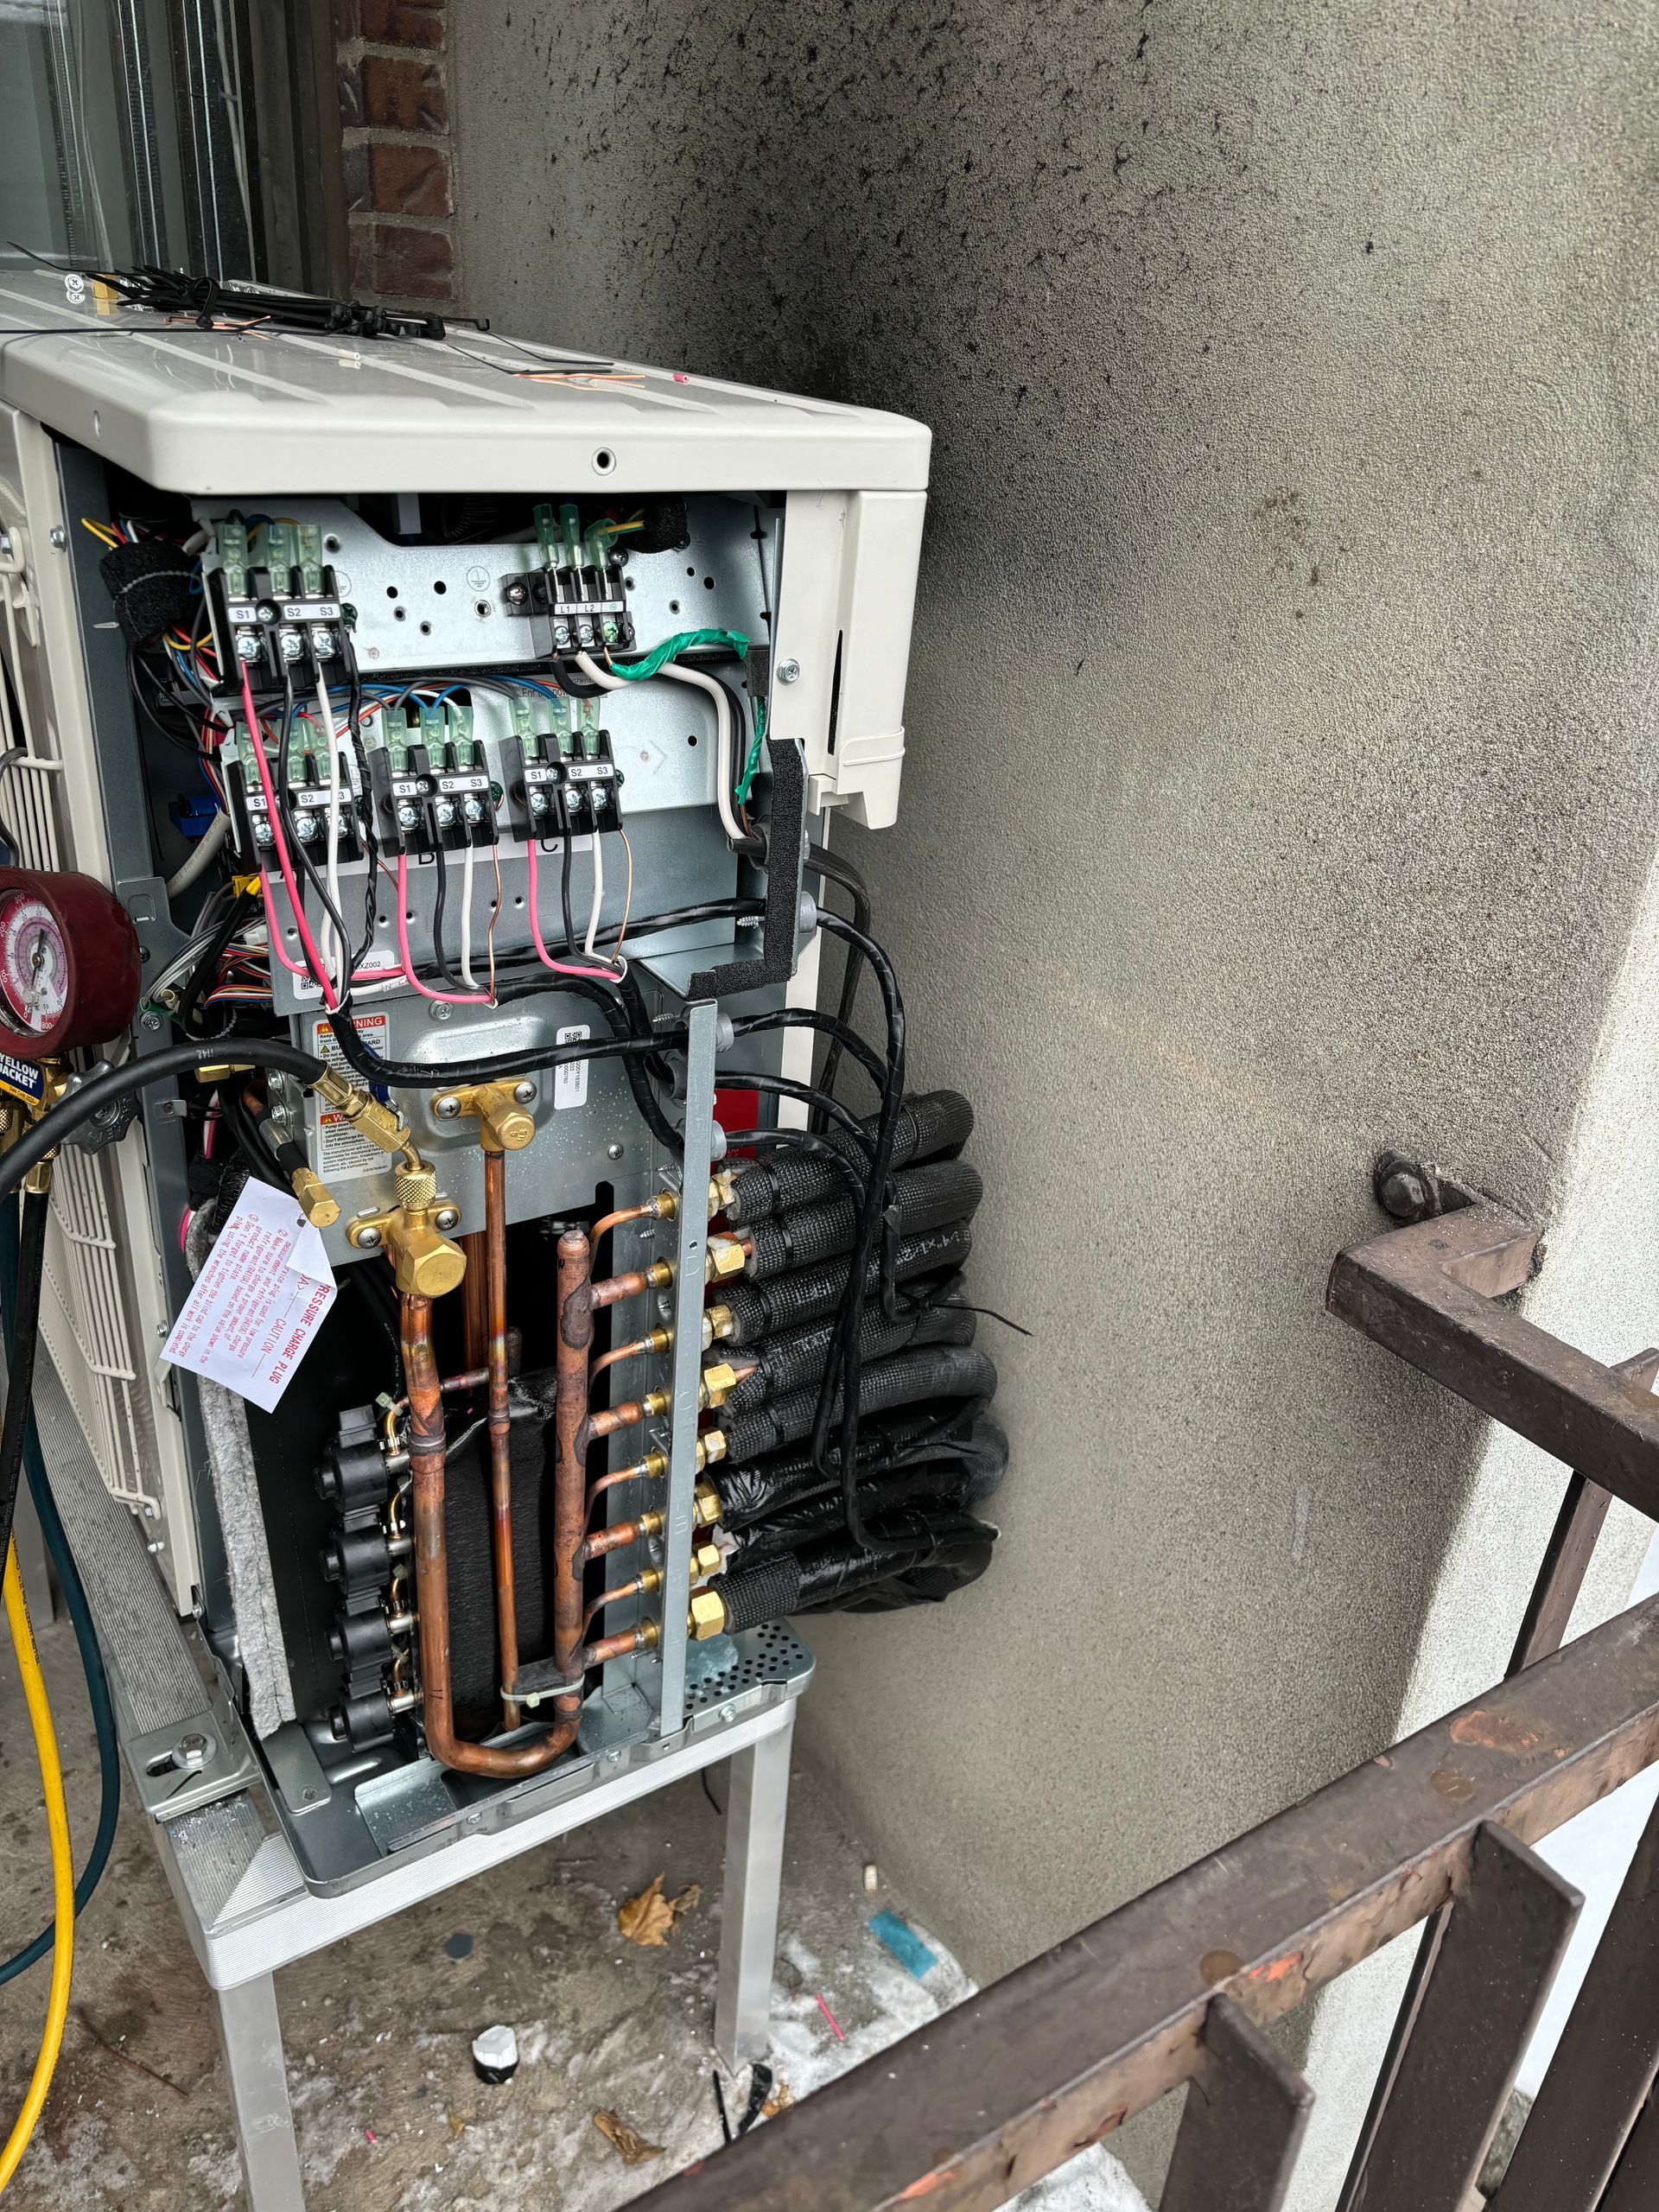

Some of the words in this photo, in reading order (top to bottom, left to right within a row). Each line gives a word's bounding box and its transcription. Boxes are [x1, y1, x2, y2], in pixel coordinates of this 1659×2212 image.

[237, 610, 249, 619] S1
[287, 608, 301, 617] S2
[320, 607, 334, 615] S3
[531, 771, 542, 779] S1
[399, 785, 411, 793] S1
[442, 781, 454, 790] S2
[470, 779, 482, 787] S3
[253, 798, 266, 807] S1
[301, 795, 315, 804] S2
[0, 1052, 38, 1080] YELLOW
[221, 1230, 236, 1248] using
[245, 1225, 264, 1249] product
[269, 1236, 283, 1251] Make
[216, 1248, 227, 1260] the
[227, 1238, 245, 1259] forget
[238, 1249, 250, 1263] name
[262, 1250, 273, 1265] sure
[269, 1240, 290, 1275] measurement
[203, 1259, 221, 1284] wrenches
[212, 1267, 229, 1289] tighten
[246, 1273, 262, 1294] charge
[263, 1275, 273, 1287] and
[195, 1283, 209, 1300] after
[207, 1288, 218, 1300] the
[231, 1285, 244, 1301] based
[268, 1283, 281, 1298] plug
[190, 1299, 201, 1310] all
[200, 1299, 213, 1315] blind
[235, 1298, 248, 1314] proper
[258, 1305, 270, 1318] used
[299, 1282, 330, 1327] RESSURE
[184, 1309, 196, 1323] work
[194, 1313, 204, 1325] cap
[221, 1309, 232, 1319] the
[214, 1319, 226, 1333] value
[226, 1315, 239, 1333] amount
[253, 1317, 264, 1327] for
[186, 1332, 197, 1342] the
[223, 1332, 232, 1341] of
[248, 1327, 258, 1338] low
[260, 1317, 287, 1354] CAUTION
[207, 1332, 219, 1349] shown
[236, 1336, 252, 1358] pressure
[281, 1326, 306, 1360] CHARGE
[177, 1340, 192, 1358] charge
[199, 1355, 208, 1364] the
[268, 1360, 288, 1384] PLUG
